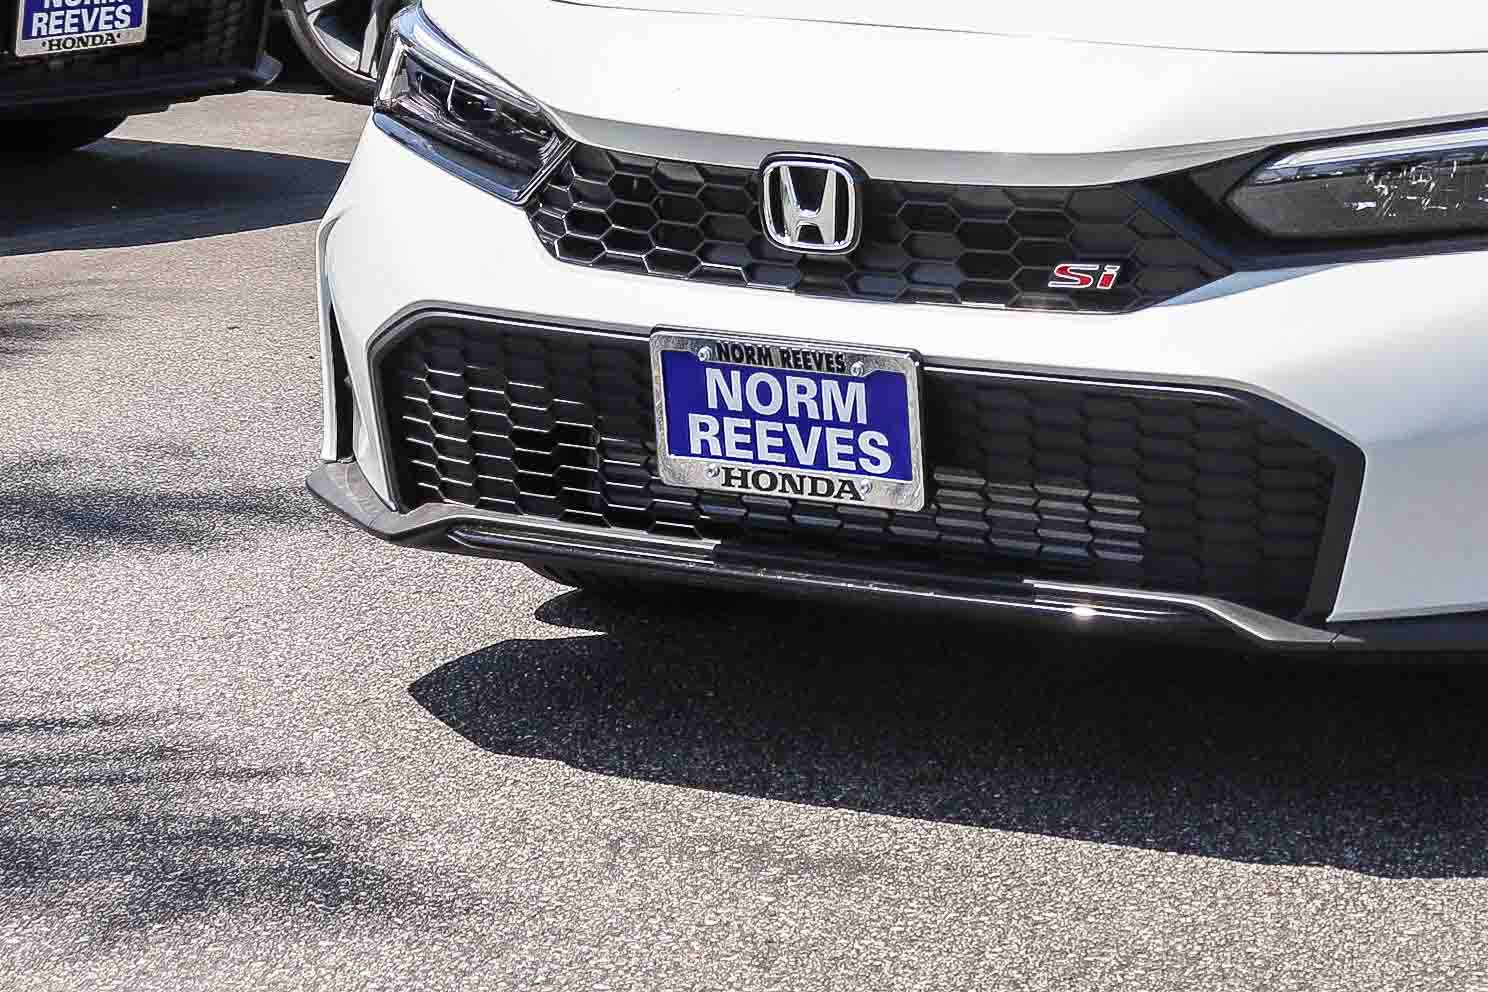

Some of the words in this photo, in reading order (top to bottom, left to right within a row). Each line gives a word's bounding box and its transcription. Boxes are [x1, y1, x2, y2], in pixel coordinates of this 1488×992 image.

[31, 5, 131, 37] REEVES
[48, 32, 118, 50] HONDA
[1047, 262, 1122, 290] Si
[716, 341, 774, 368] NORM
[778, 347, 847, 373] REEVES
[705, 367, 868, 425] NORM
[687, 412, 893, 475] REEVES
[721, 466, 865, 502] HONDA
